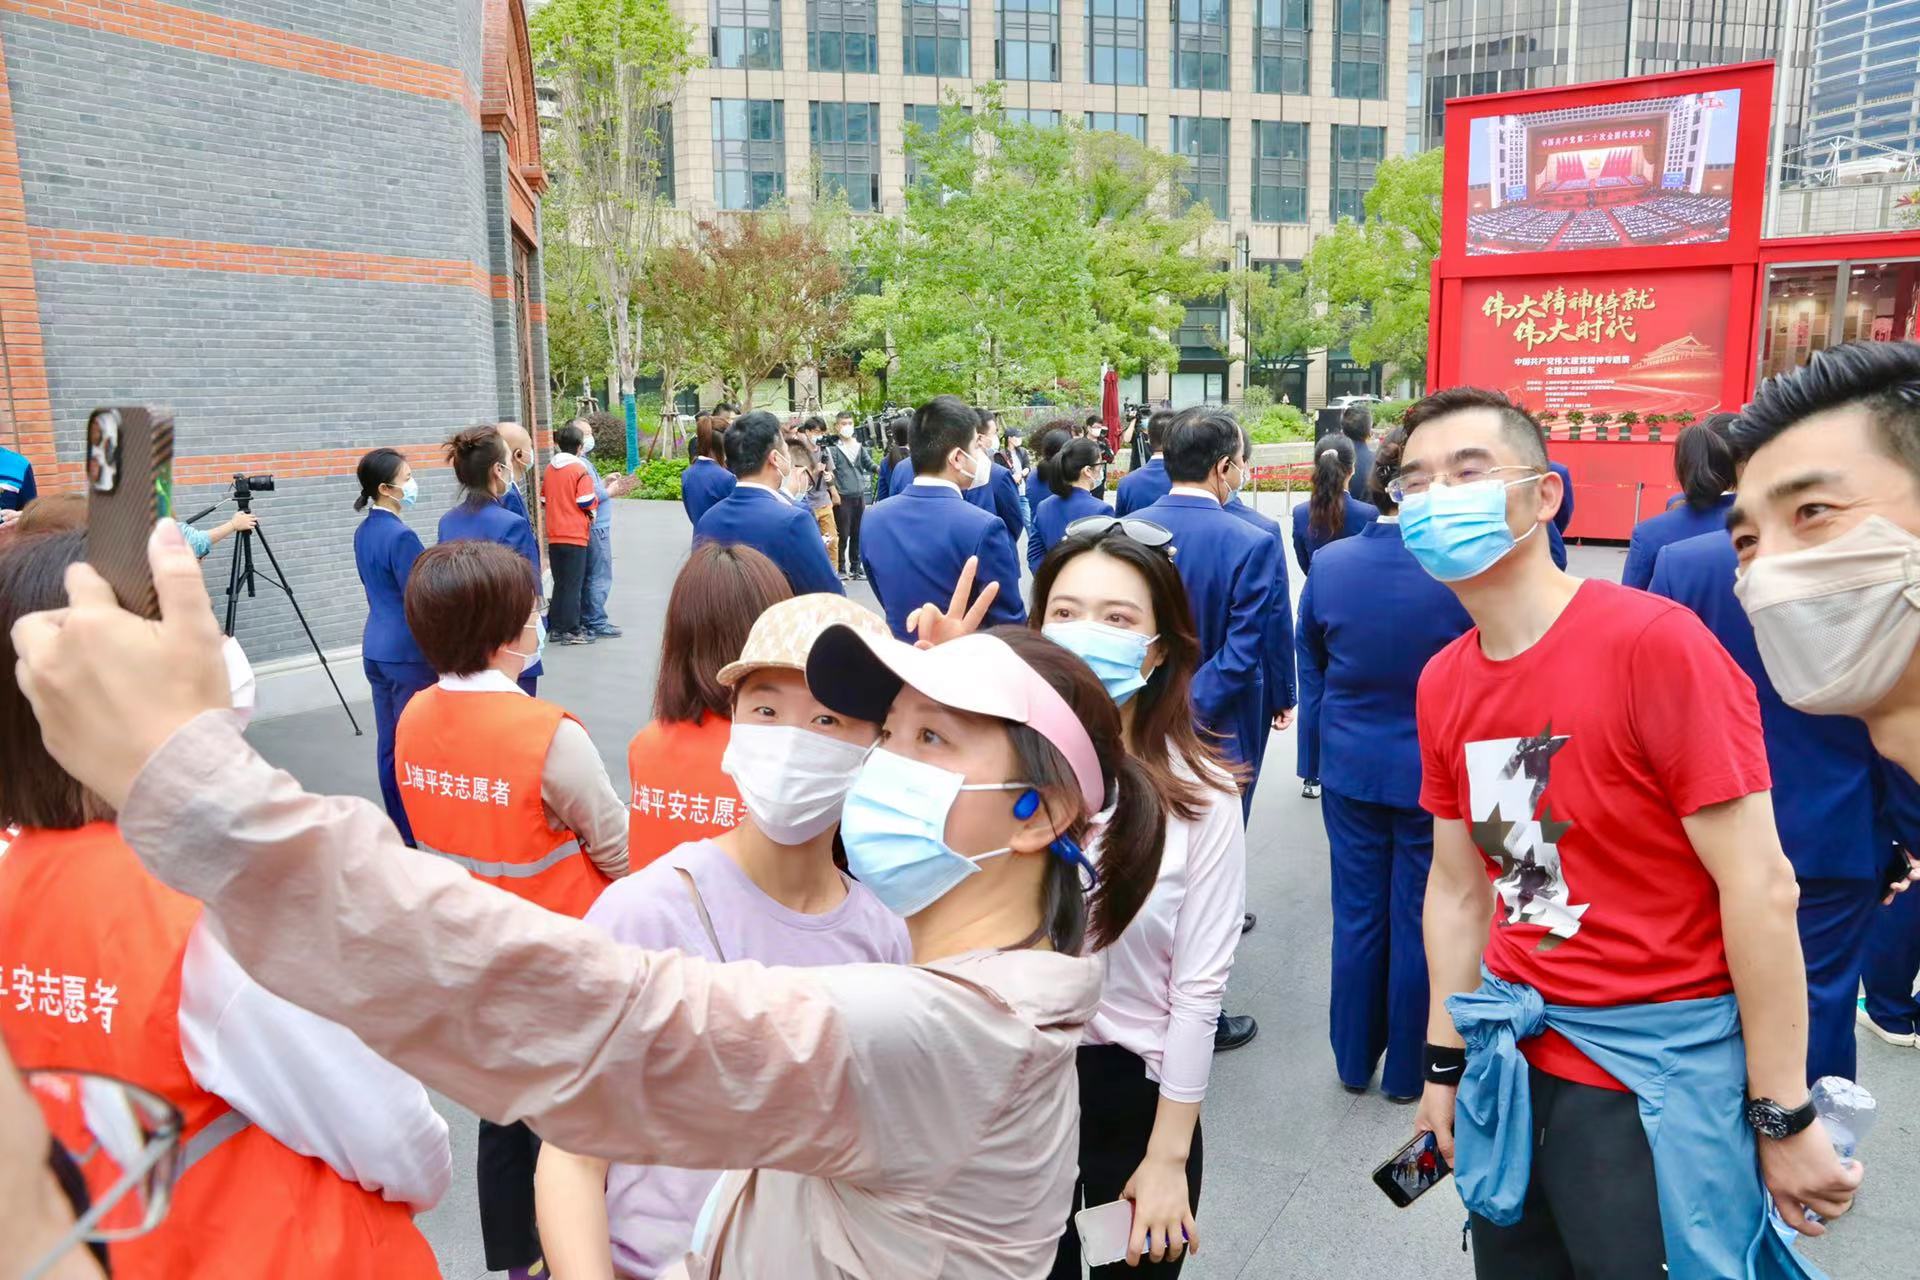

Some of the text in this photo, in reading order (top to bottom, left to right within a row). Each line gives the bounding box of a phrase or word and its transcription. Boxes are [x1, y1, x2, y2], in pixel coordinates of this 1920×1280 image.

[1481, 285, 1656, 328] 伟大精神铸就
[1512, 315, 1637, 353] 伟大时代
